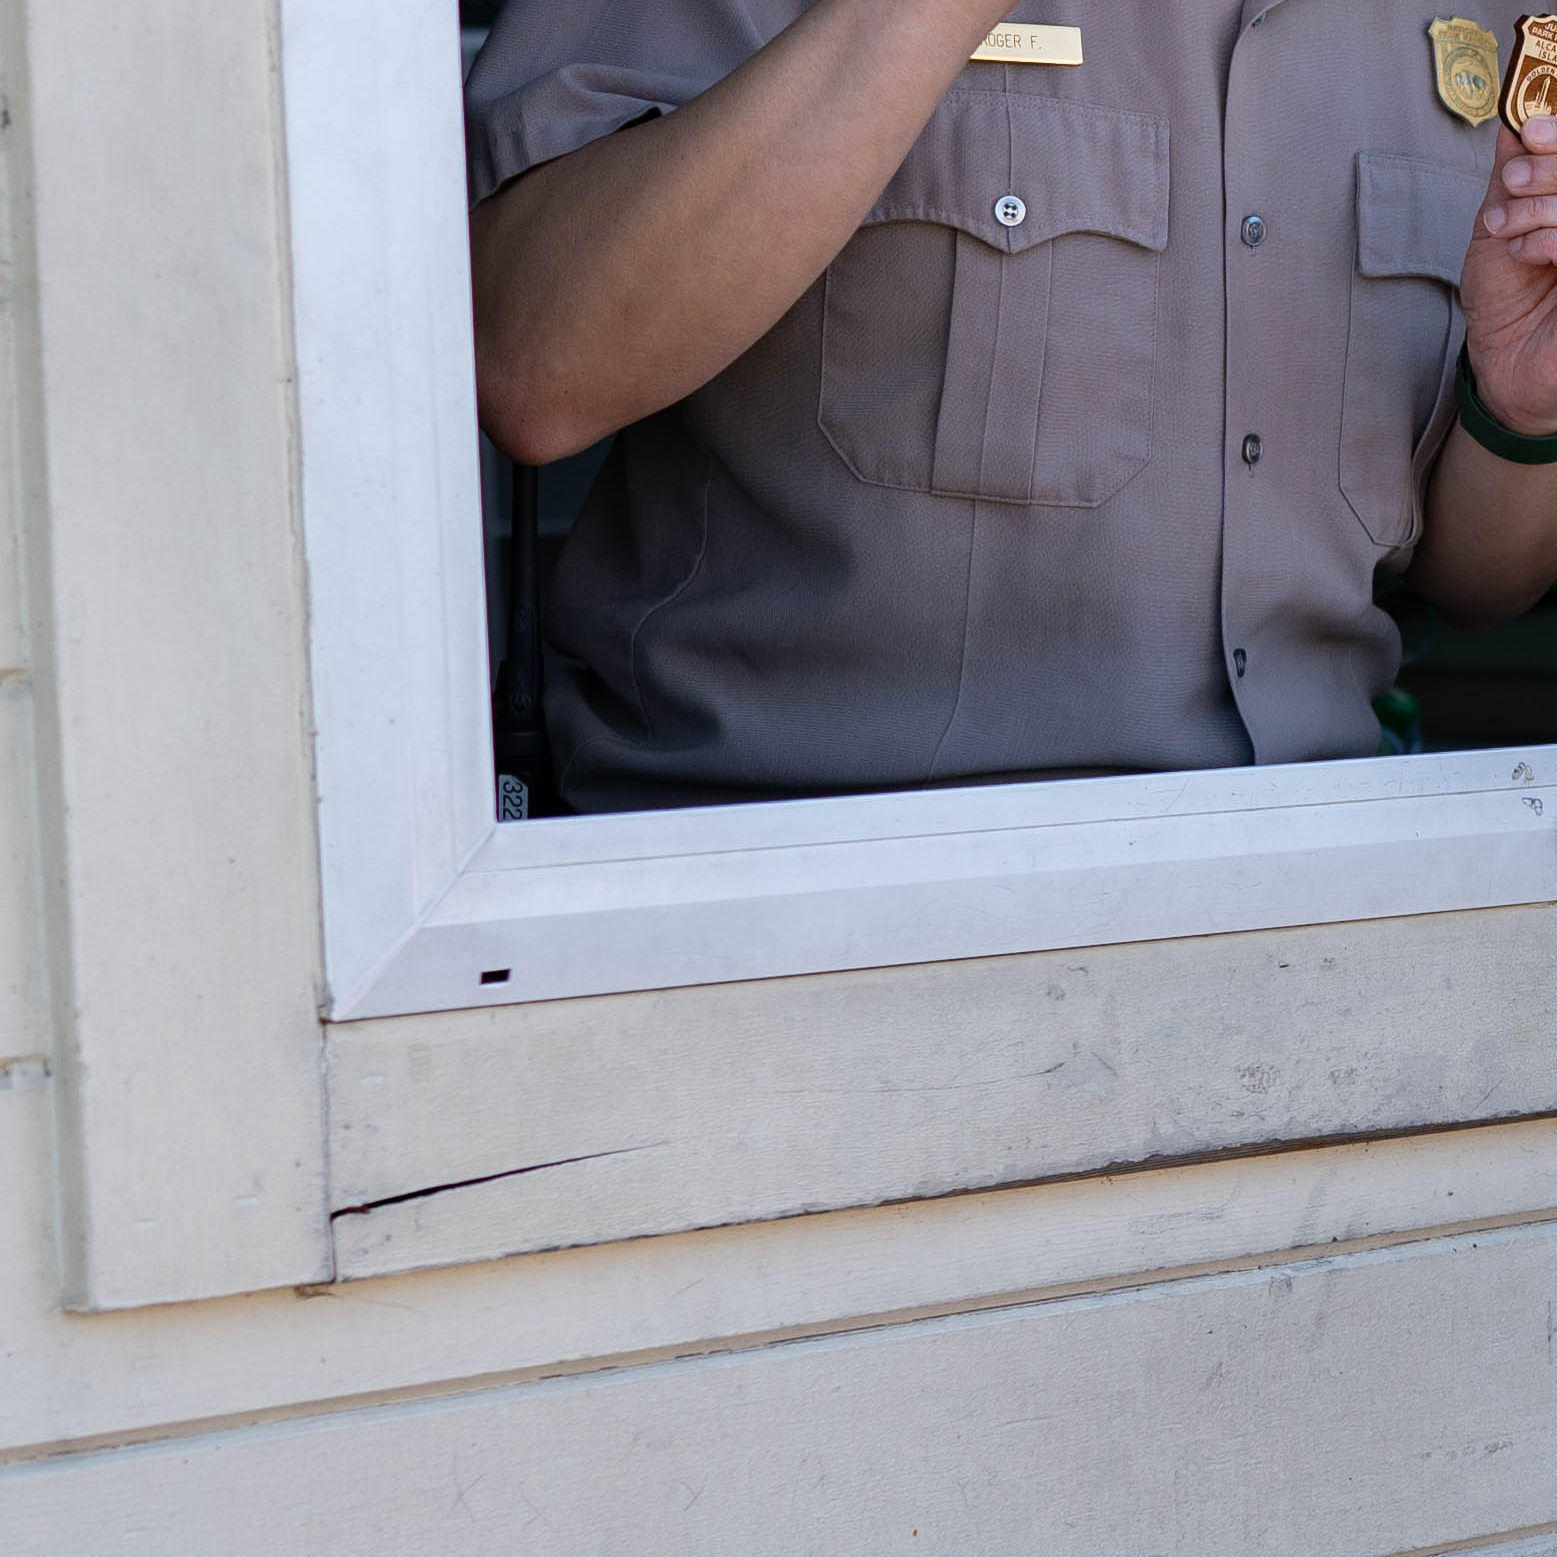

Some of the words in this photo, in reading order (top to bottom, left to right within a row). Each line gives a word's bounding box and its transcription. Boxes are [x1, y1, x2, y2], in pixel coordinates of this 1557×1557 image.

[1531, 27, 1553, 40] PARK
[1030, 35, 1042, 50] F.
[1526, 66, 1555, 82] GOLDEN
[503, 780, 524, 820] 322
